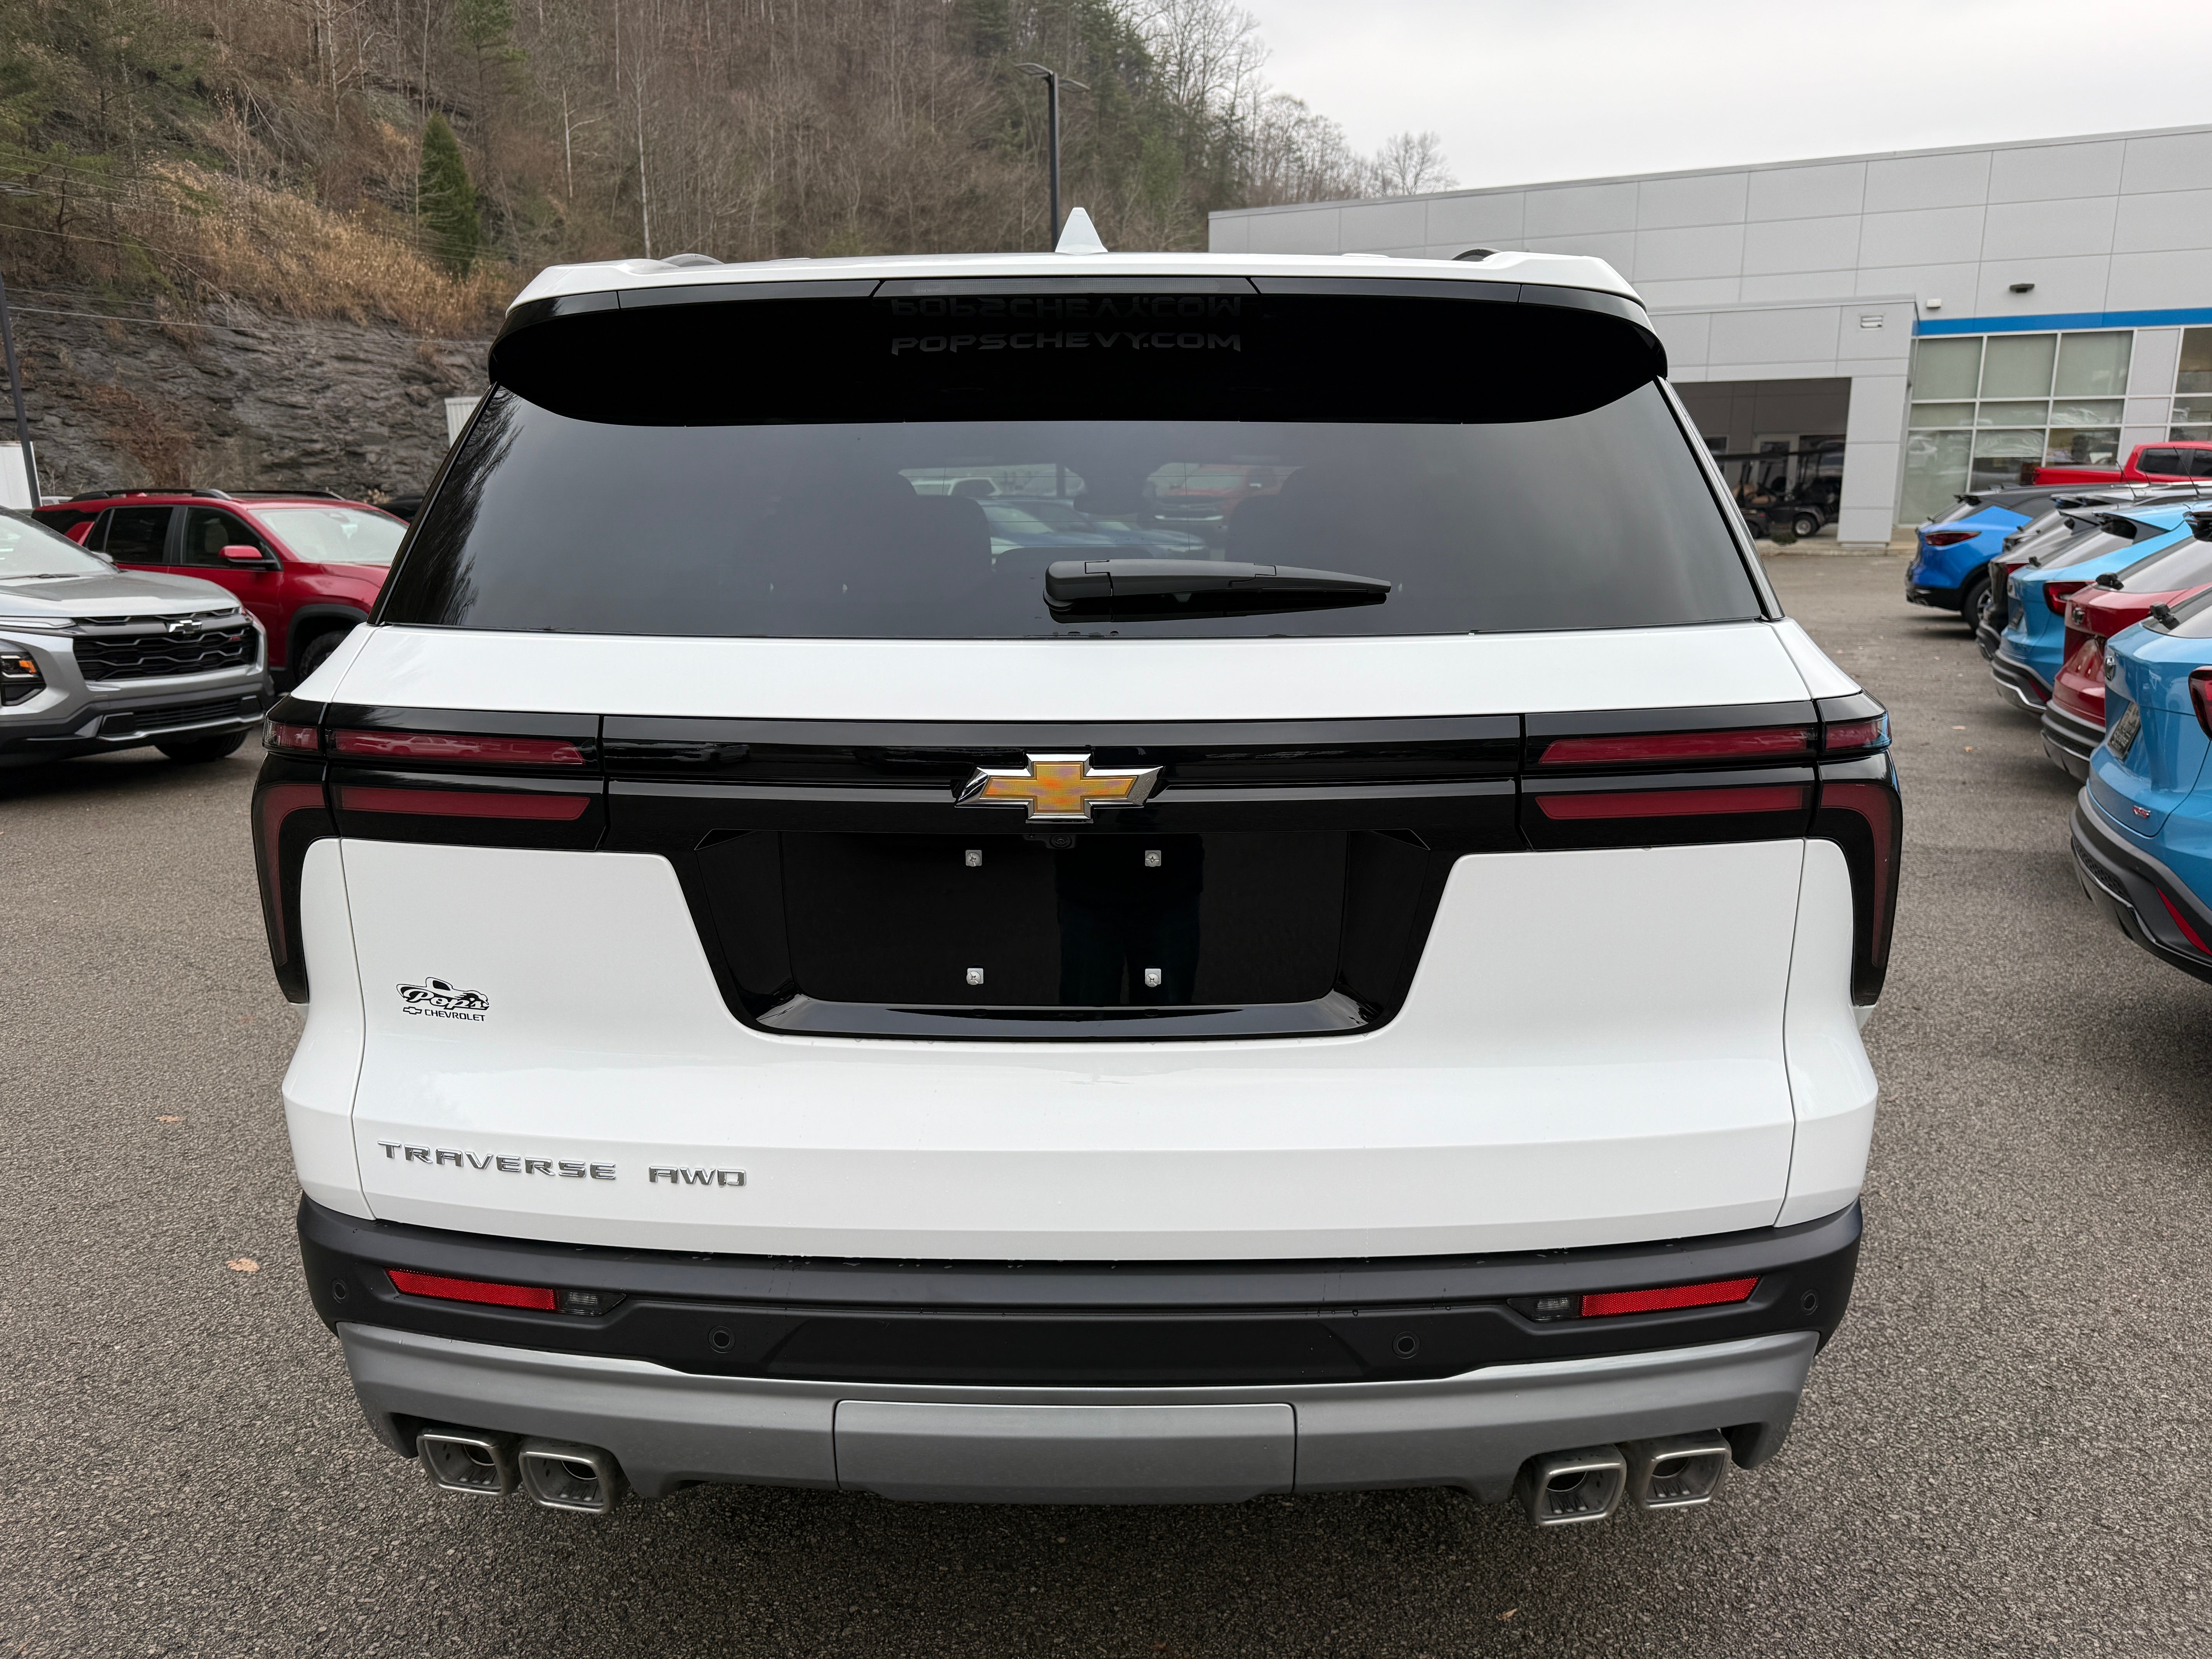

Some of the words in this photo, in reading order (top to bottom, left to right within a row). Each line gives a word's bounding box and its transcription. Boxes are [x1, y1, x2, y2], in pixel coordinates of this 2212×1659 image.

[891, 331, 1241, 356] POPSCHEVY.COM
[424, 1009, 485, 1021] CHEVROLET
[377, 1140, 617, 1180] TRAVERSE
[649, 1166, 747, 1187] AWD
